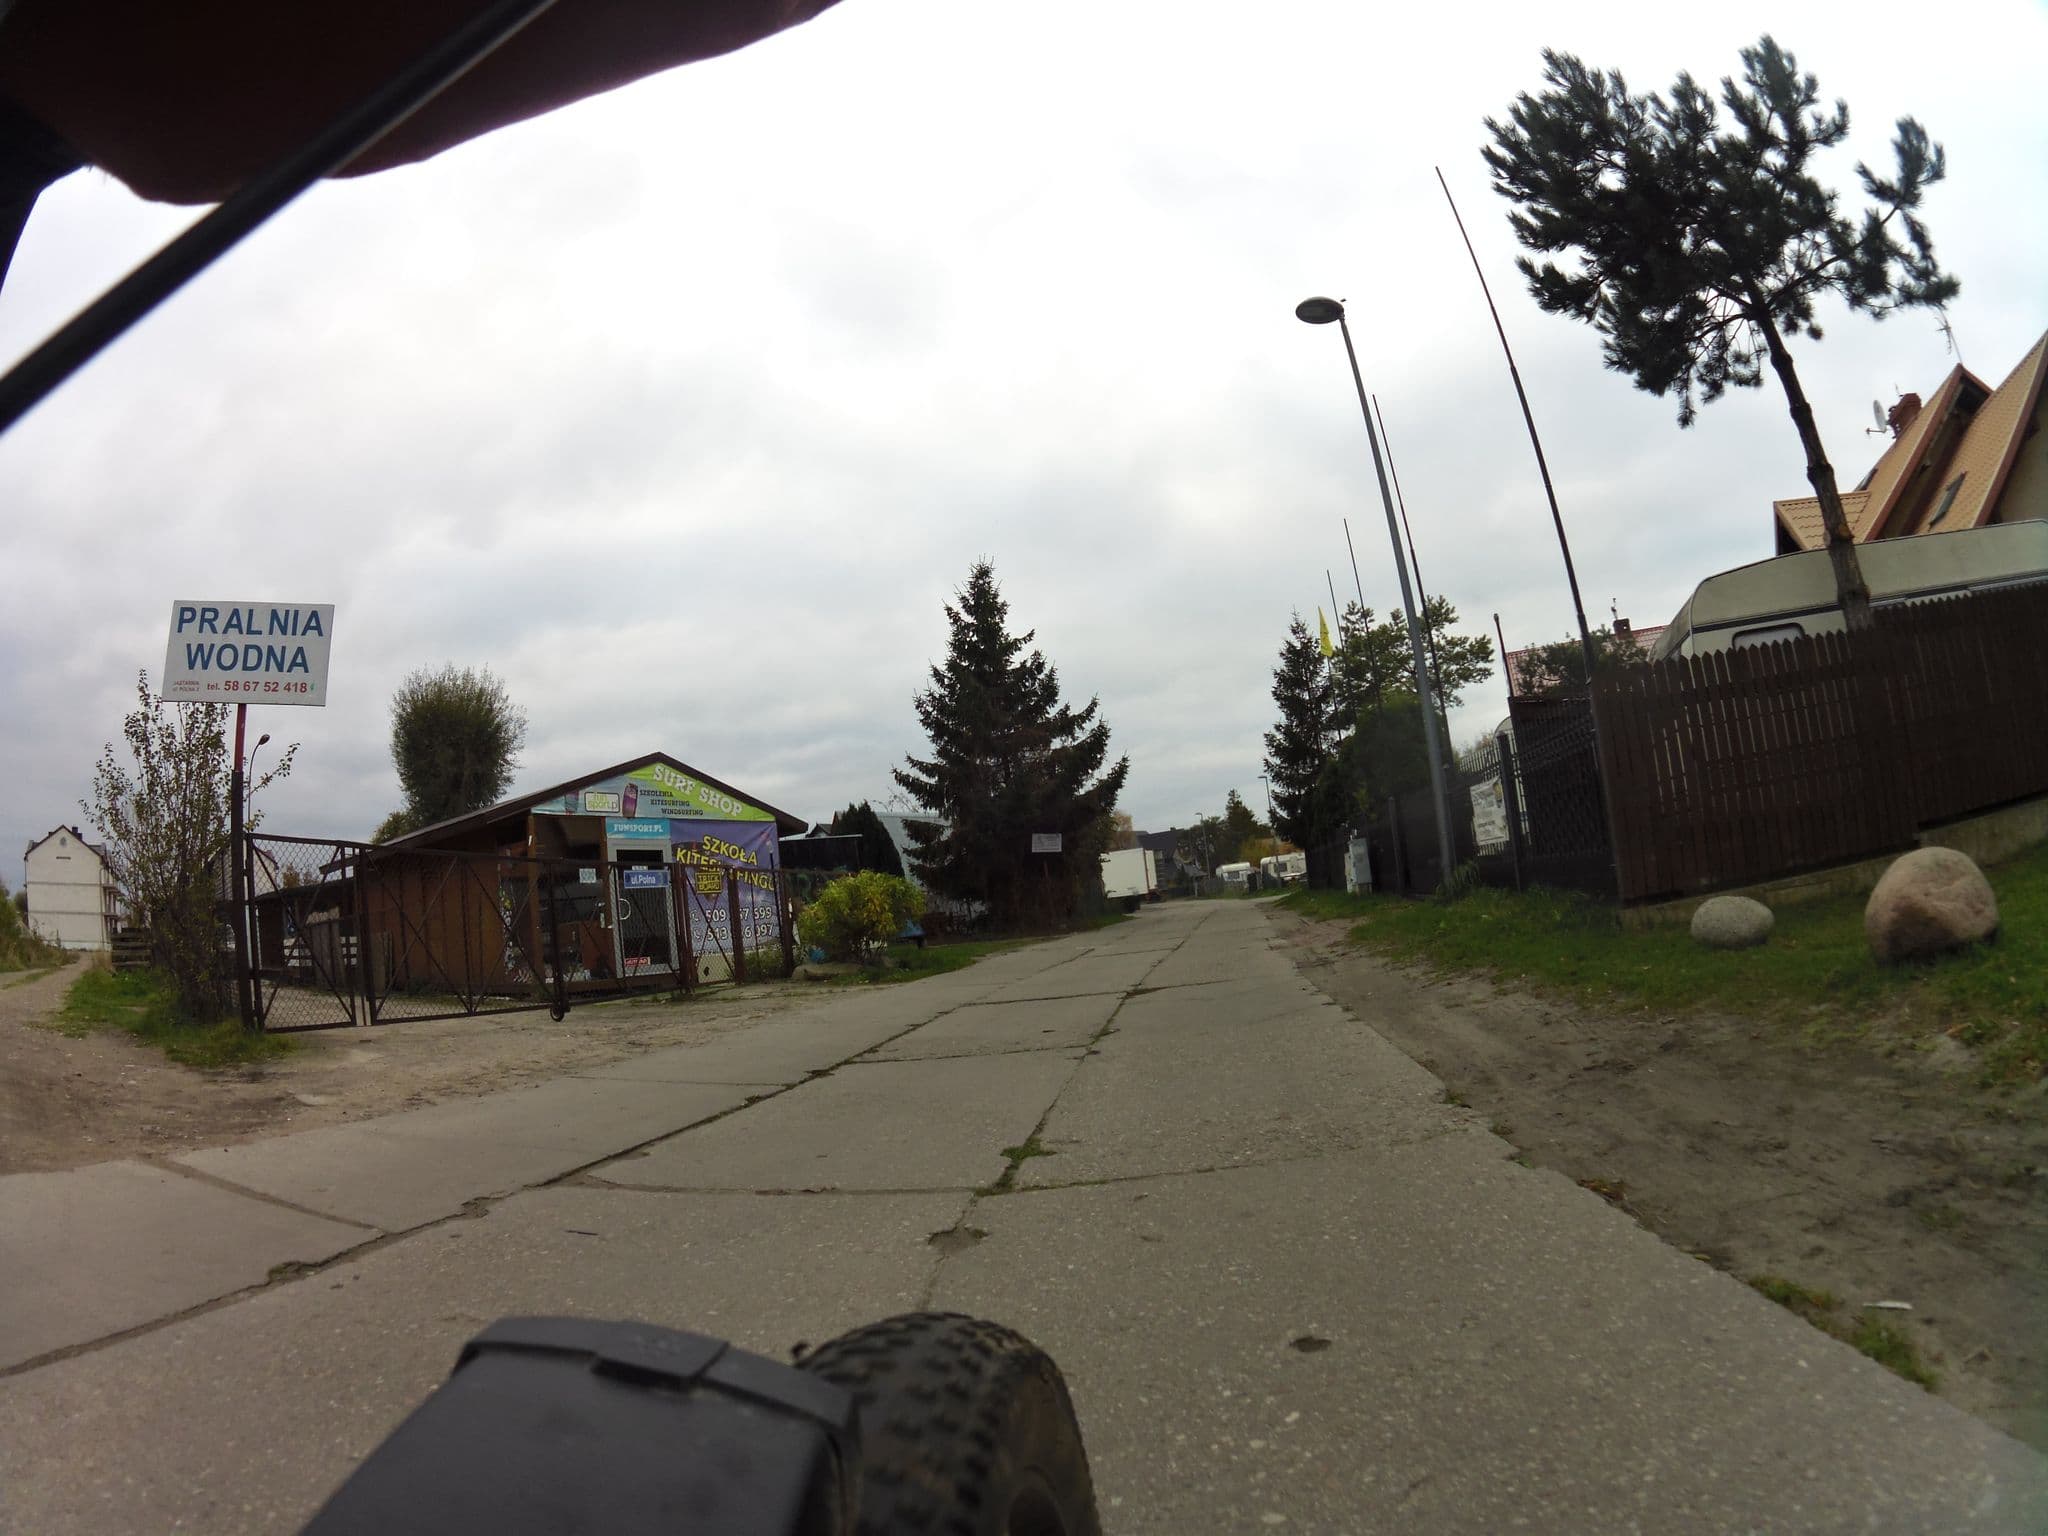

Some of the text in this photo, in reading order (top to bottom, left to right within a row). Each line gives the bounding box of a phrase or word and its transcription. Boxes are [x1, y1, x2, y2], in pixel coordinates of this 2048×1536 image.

[177, 606, 323, 637] PRALNIA
[186, 643, 309, 673] WODNA
[206, 680, 307, 693] tel. 58 67 52 418
[640, 789, 674, 798] SZKOLENIA
[653, 764, 743, 817] SURF SHOP
[661, 808, 704, 816] WINDSURFING
[702, 835, 758, 866] SZKOŁA
